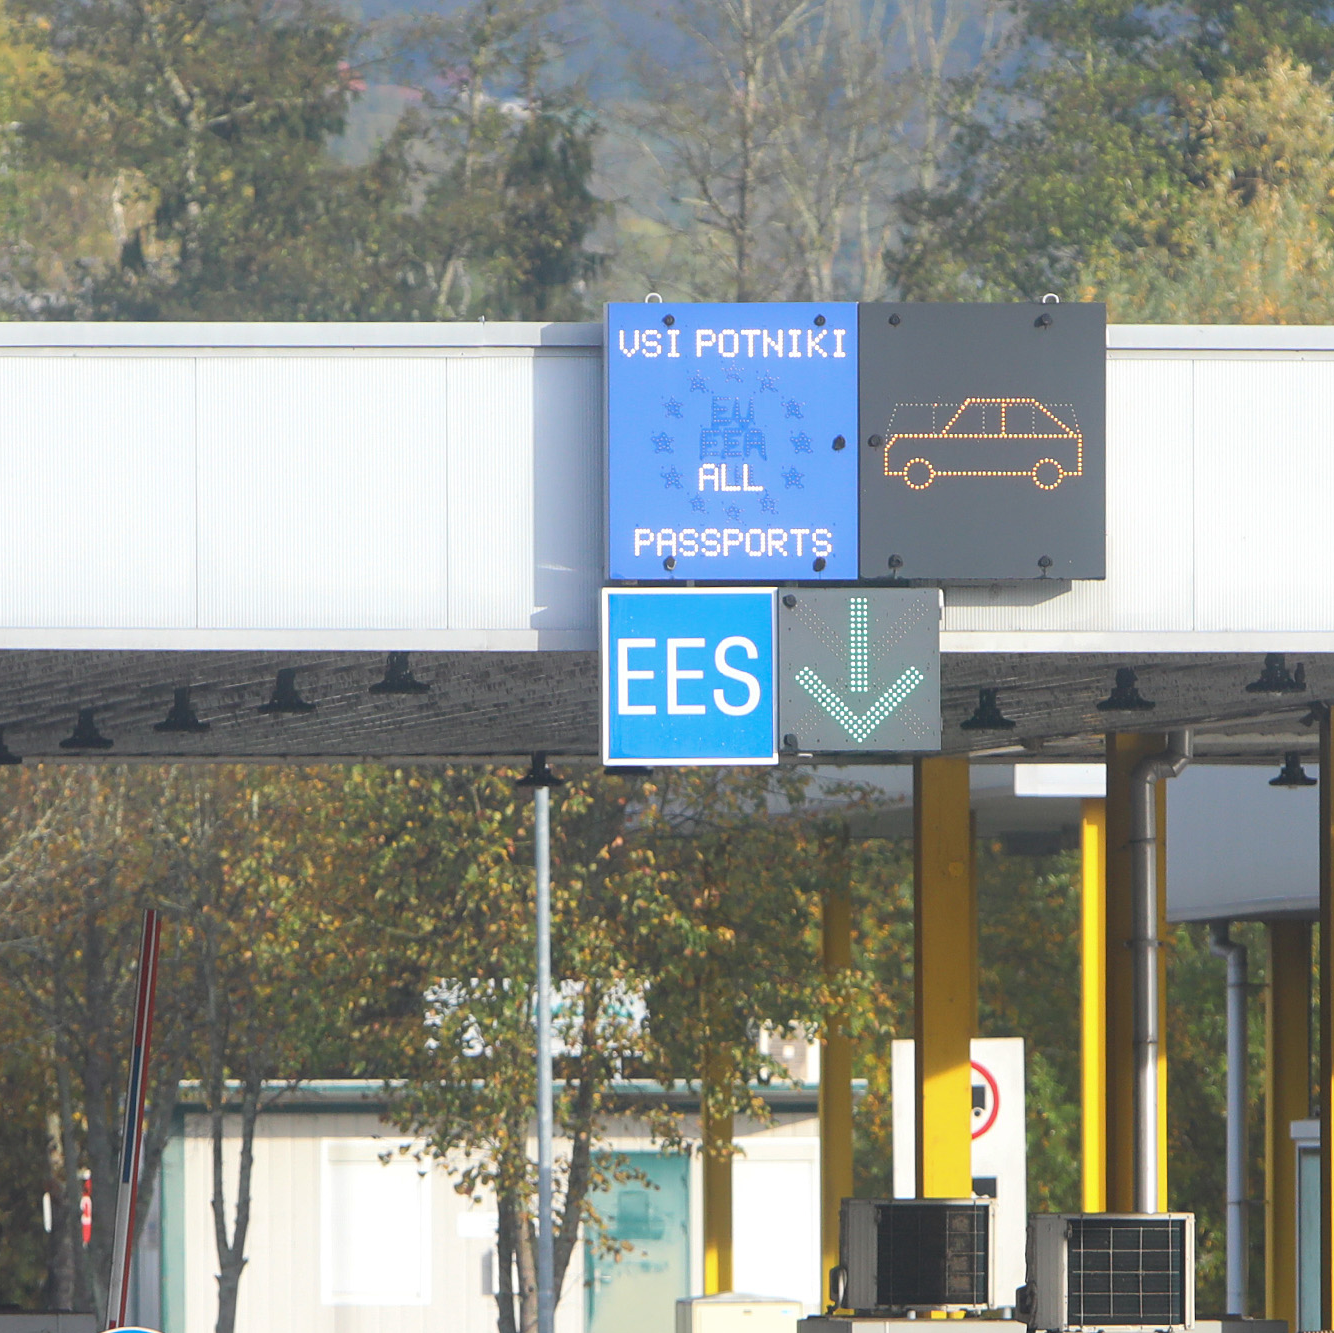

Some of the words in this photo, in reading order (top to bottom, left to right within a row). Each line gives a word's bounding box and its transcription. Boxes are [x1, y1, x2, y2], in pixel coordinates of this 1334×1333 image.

[619, 329, 680, 357] VSI
[695, 329, 846, 357] POTNIKI
[711, 397, 755, 425] EU
[701, 428, 765, 457] EEA
[698, 463, 763, 491] ALL
[634, 528, 833, 557] PASSPORTS
[617, 635, 761, 716] EES
